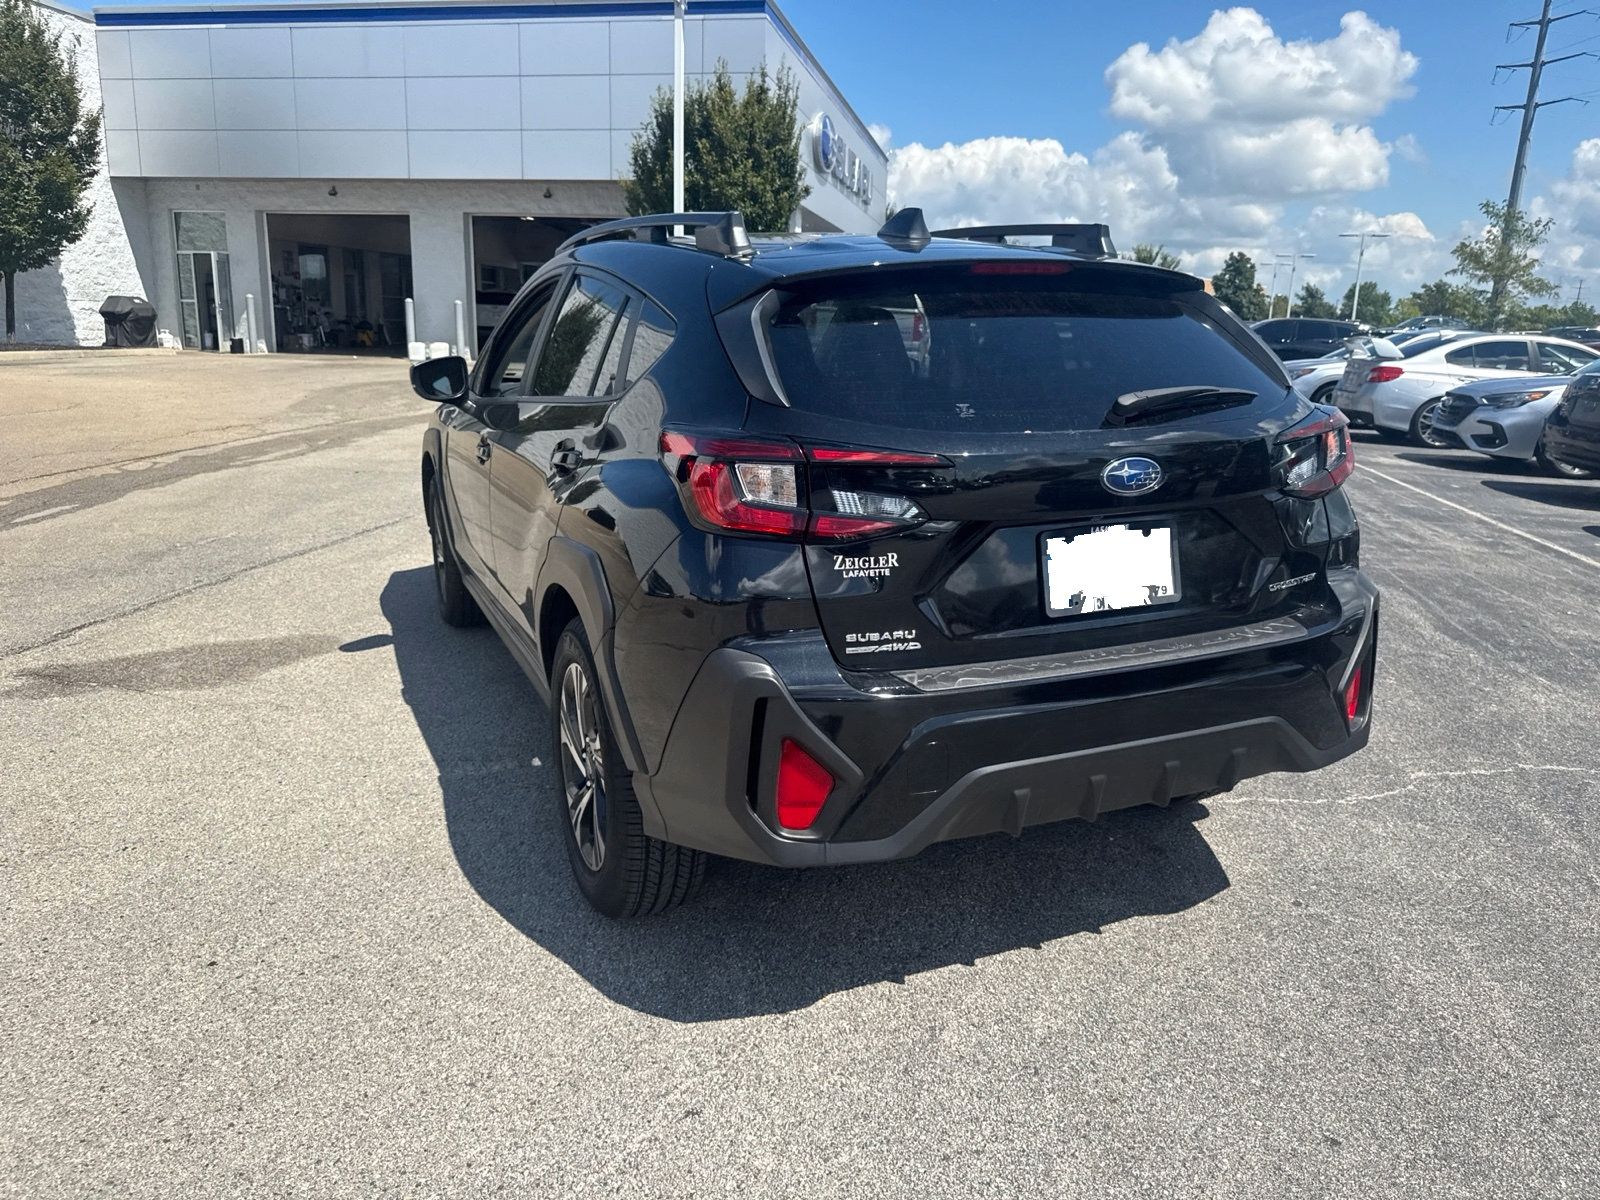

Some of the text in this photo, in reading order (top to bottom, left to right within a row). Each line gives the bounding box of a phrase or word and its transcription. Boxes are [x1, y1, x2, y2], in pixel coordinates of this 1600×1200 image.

[833, 552, 899, 570] ZEIGLER
[843, 568, 890, 578] LAFAYETTE
[845, 629, 916, 642] SUBARU
[874, 641, 922, 652] AWD
